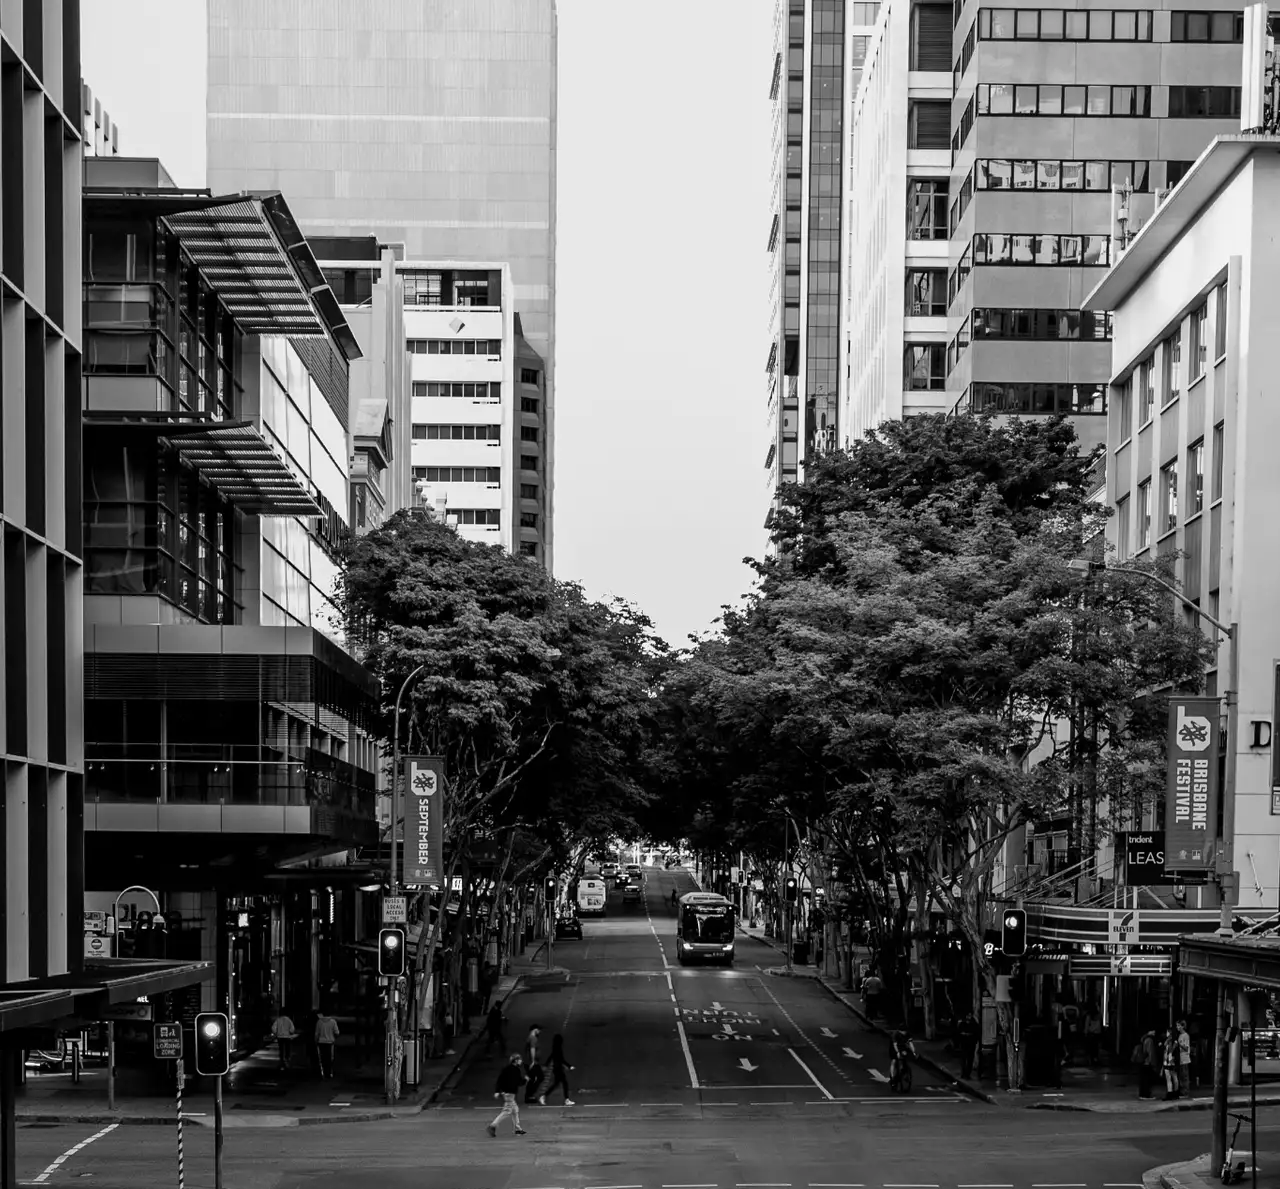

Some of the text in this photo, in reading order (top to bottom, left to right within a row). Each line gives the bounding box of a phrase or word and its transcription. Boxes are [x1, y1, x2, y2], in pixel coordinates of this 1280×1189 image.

[1175, 758, 1191, 824] FESTIVAL
[1192, 759, 1209, 831] BRISBANE
[418, 798, 429, 865] SEPTEMBER
[1128, 835, 1153, 844] trident
[1128, 851, 1165, 865] LEAS
